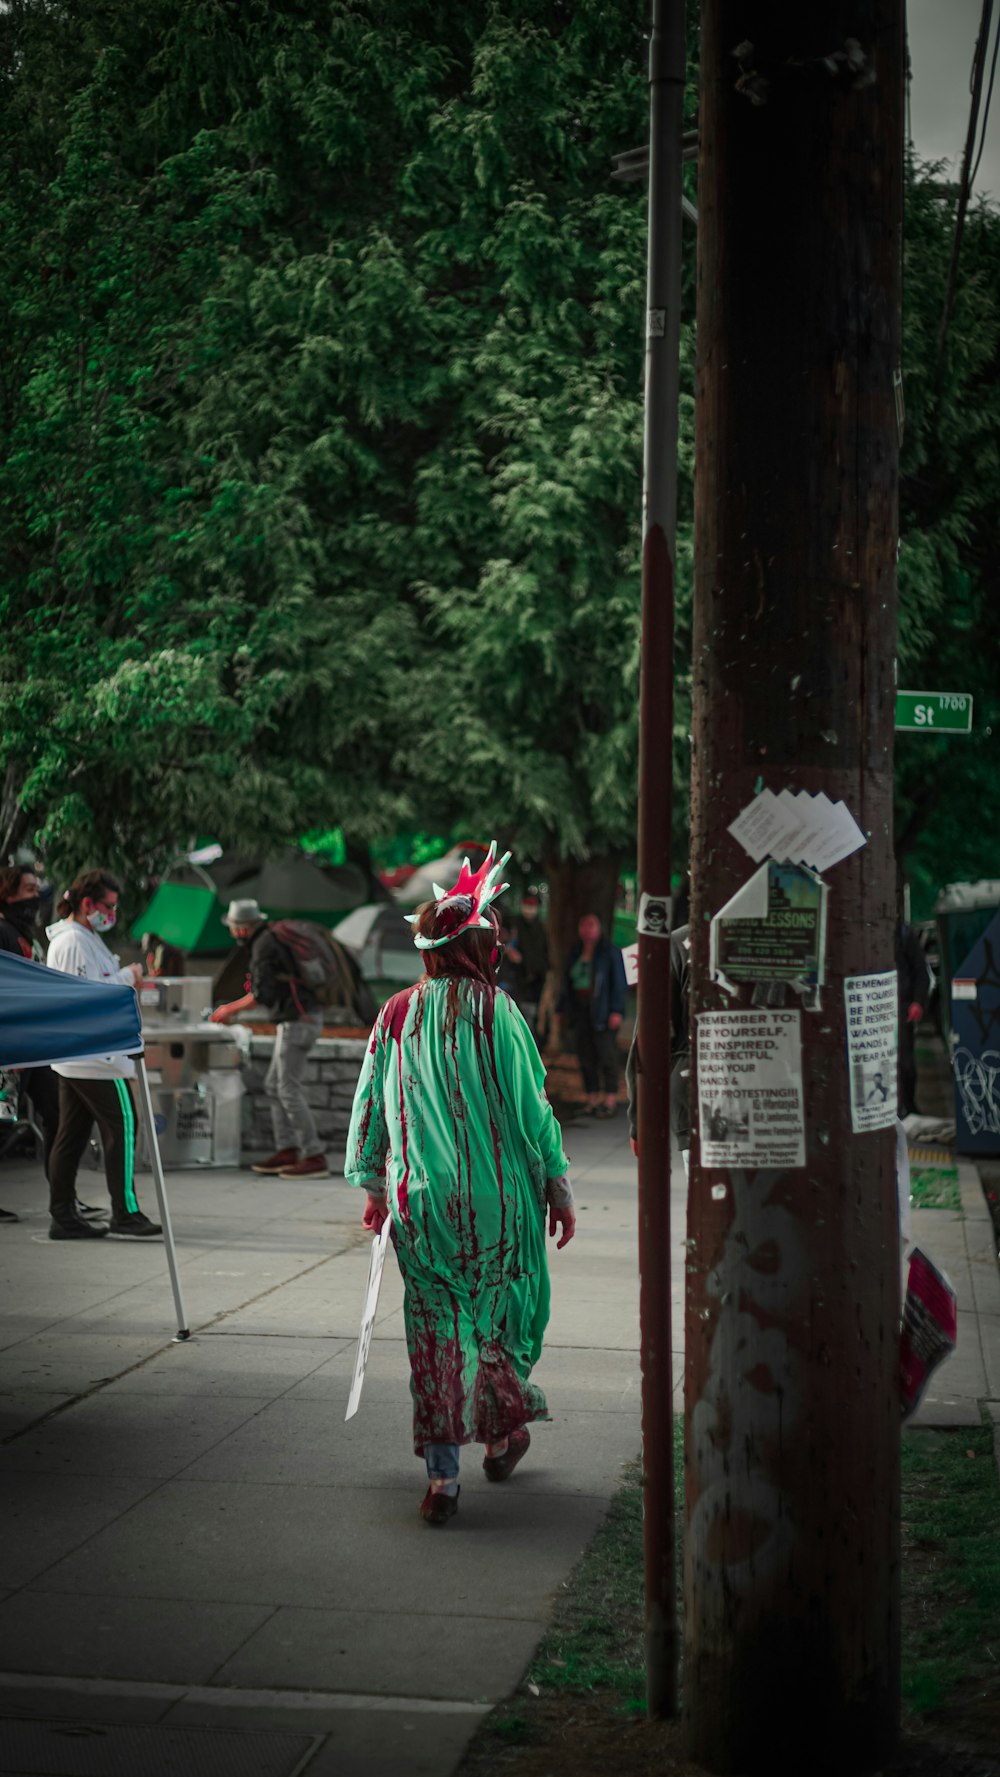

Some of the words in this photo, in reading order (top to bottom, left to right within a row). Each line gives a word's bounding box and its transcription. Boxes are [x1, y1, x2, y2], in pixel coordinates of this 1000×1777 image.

[940, 696, 966, 711] 1700
[914, 704, 934, 725] St
[762, 911, 816, 929] LESSONS
[849, 994, 863, 1002] BE
[850, 1006, 864, 1015] BE
[700, 1014, 767, 1025] REMEMBER
[771, 1013, 797, 1023] TO:
[850, 1017, 863, 1026] BE
[700, 1029, 712, 1037] BE
[851, 1028, 879, 1038] WASH
[700, 1042, 711, 1050] BE
[851, 1040, 882, 1051] HANDS
[700, 1052, 709, 1060] BE
[852, 1052, 879, 1063] WEAR
[701, 1064, 724, 1073] WASH
[727, 1064, 756, 1073] YOUR
[700, 1077, 729, 1086] HANDS
[731, 1077, 738, 1086] &
[701, 1090, 719, 1098] KEEP
[721, 1088, 798, 1098] PROTESTING!!!
[741, 1158, 758, 1166] King
